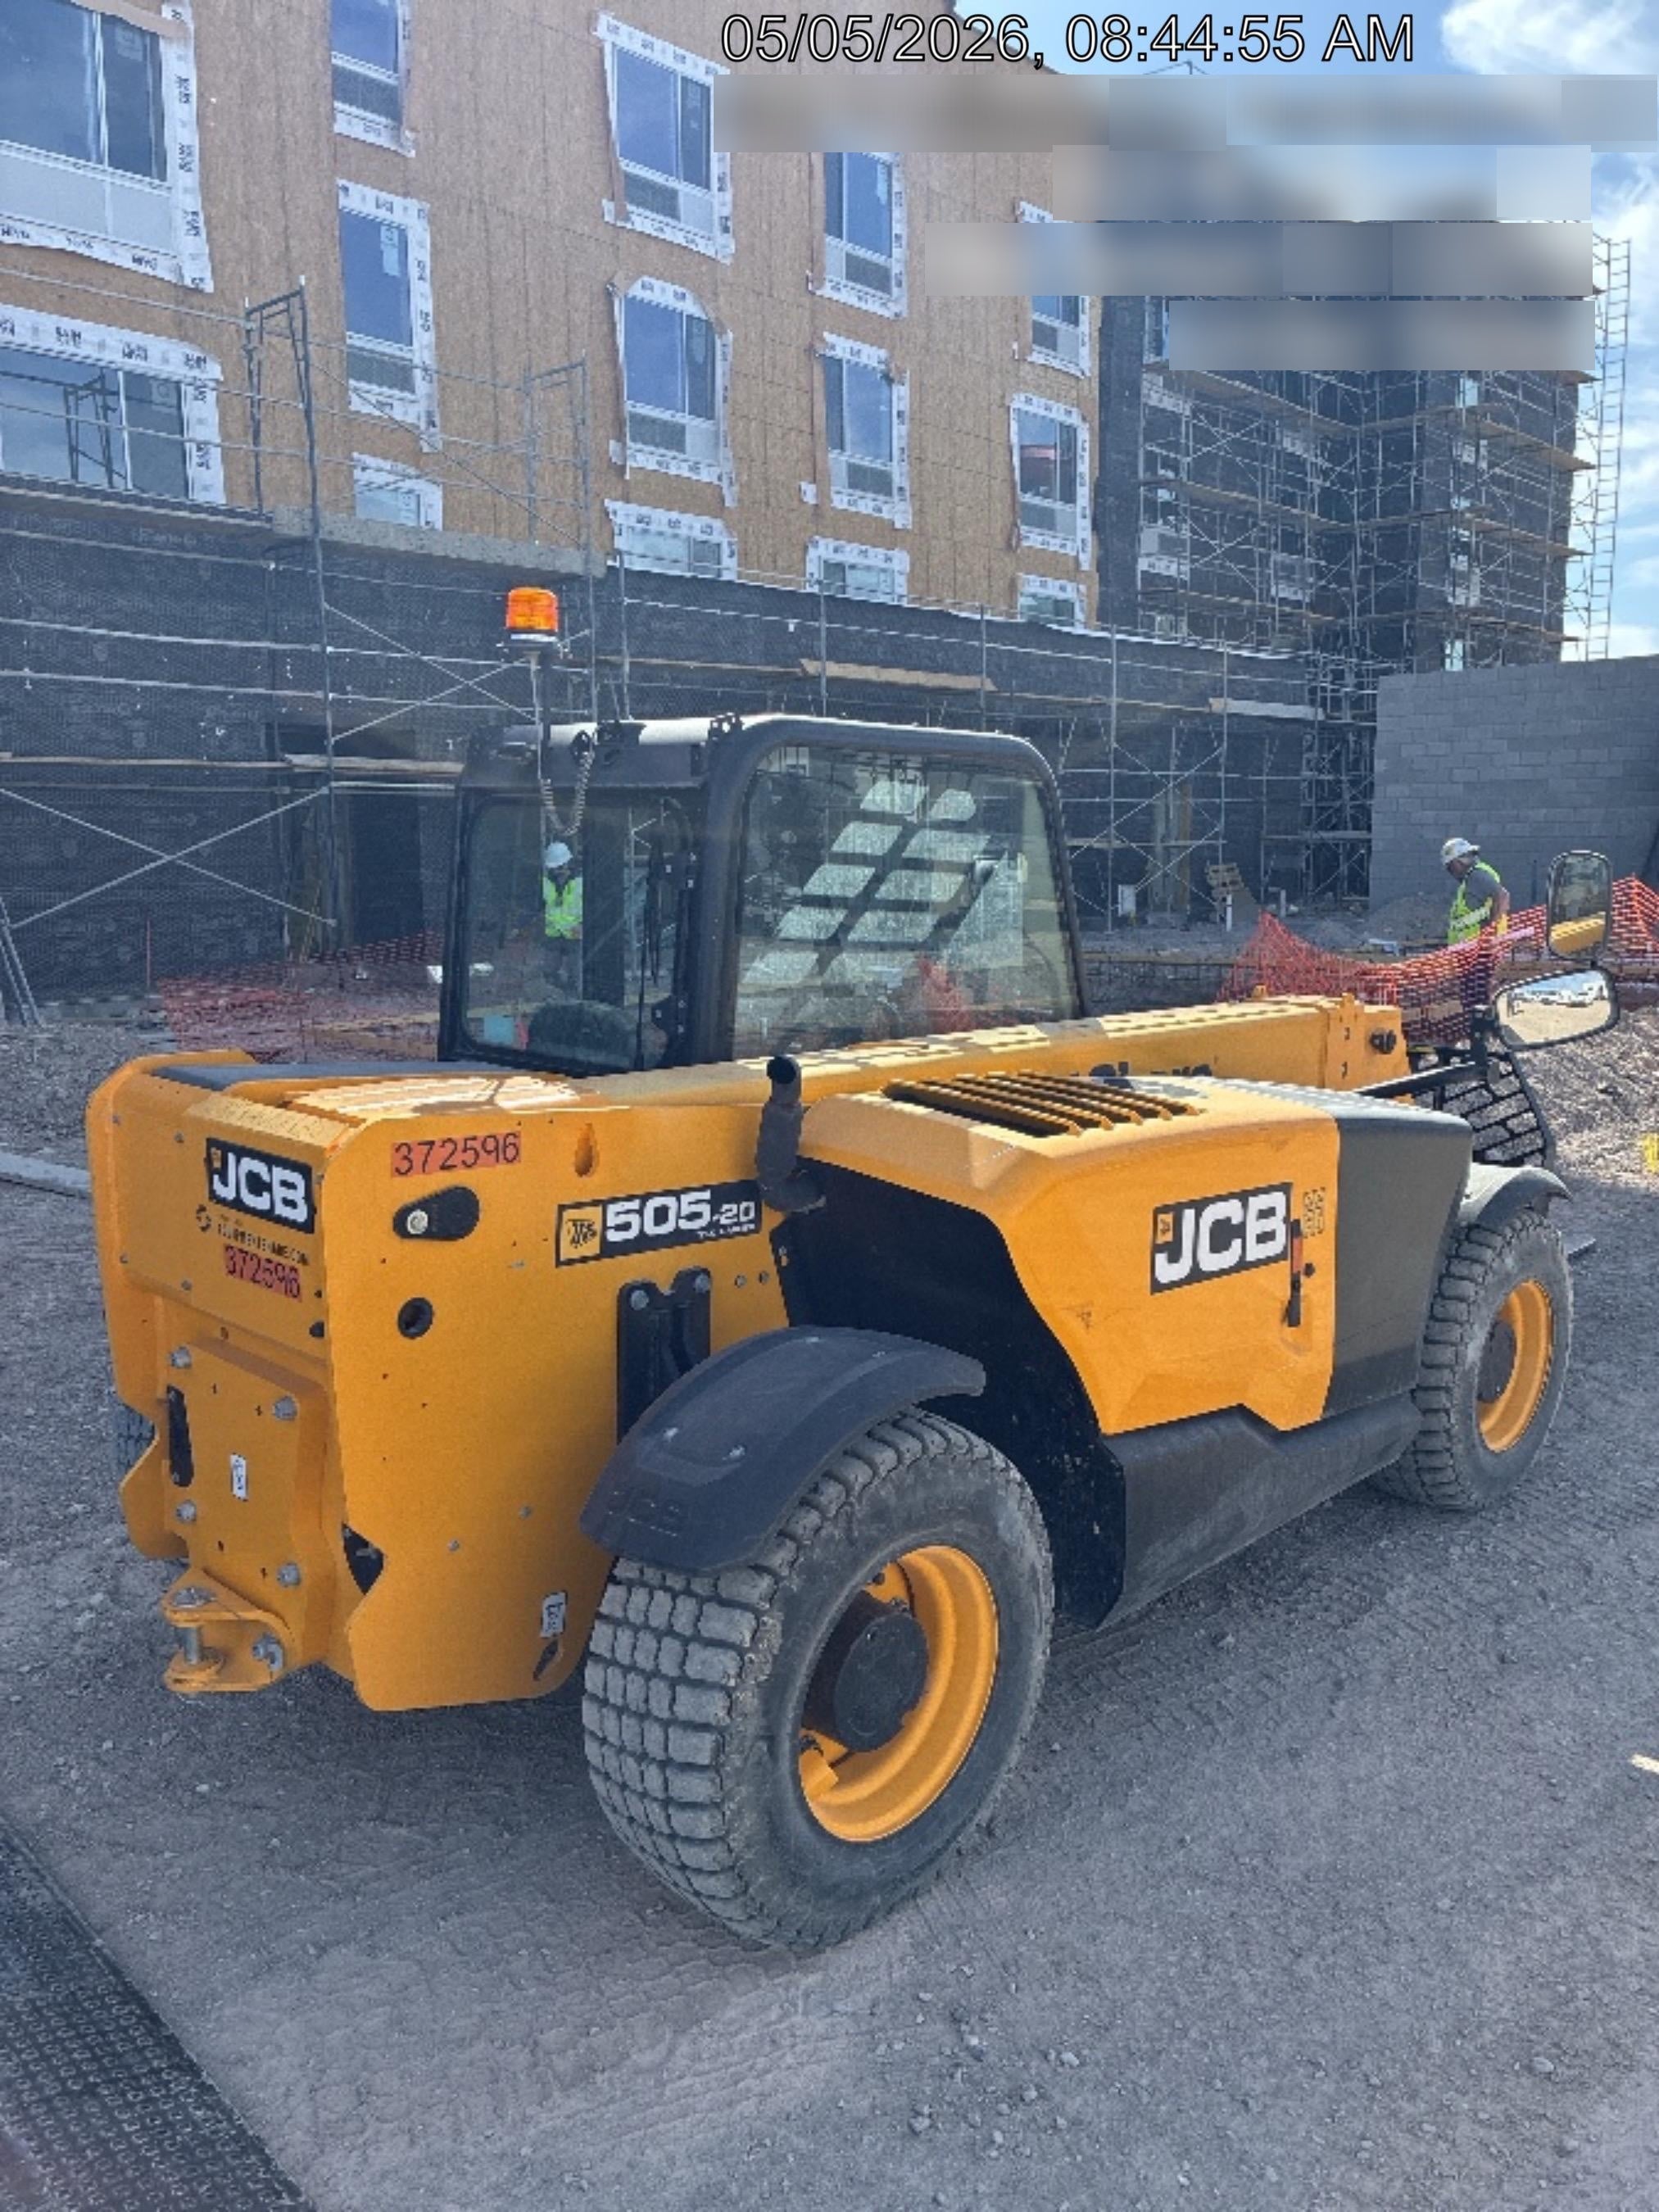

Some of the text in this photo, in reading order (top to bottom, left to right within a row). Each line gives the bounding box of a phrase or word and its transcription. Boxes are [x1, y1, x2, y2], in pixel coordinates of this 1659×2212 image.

[393, 1132, 520, 1176] 372596
[211, 1150, 308, 1223] JCB
[1154, 1191, 1287, 1285] JCB
[224, 1244, 301, 1299] 372596
